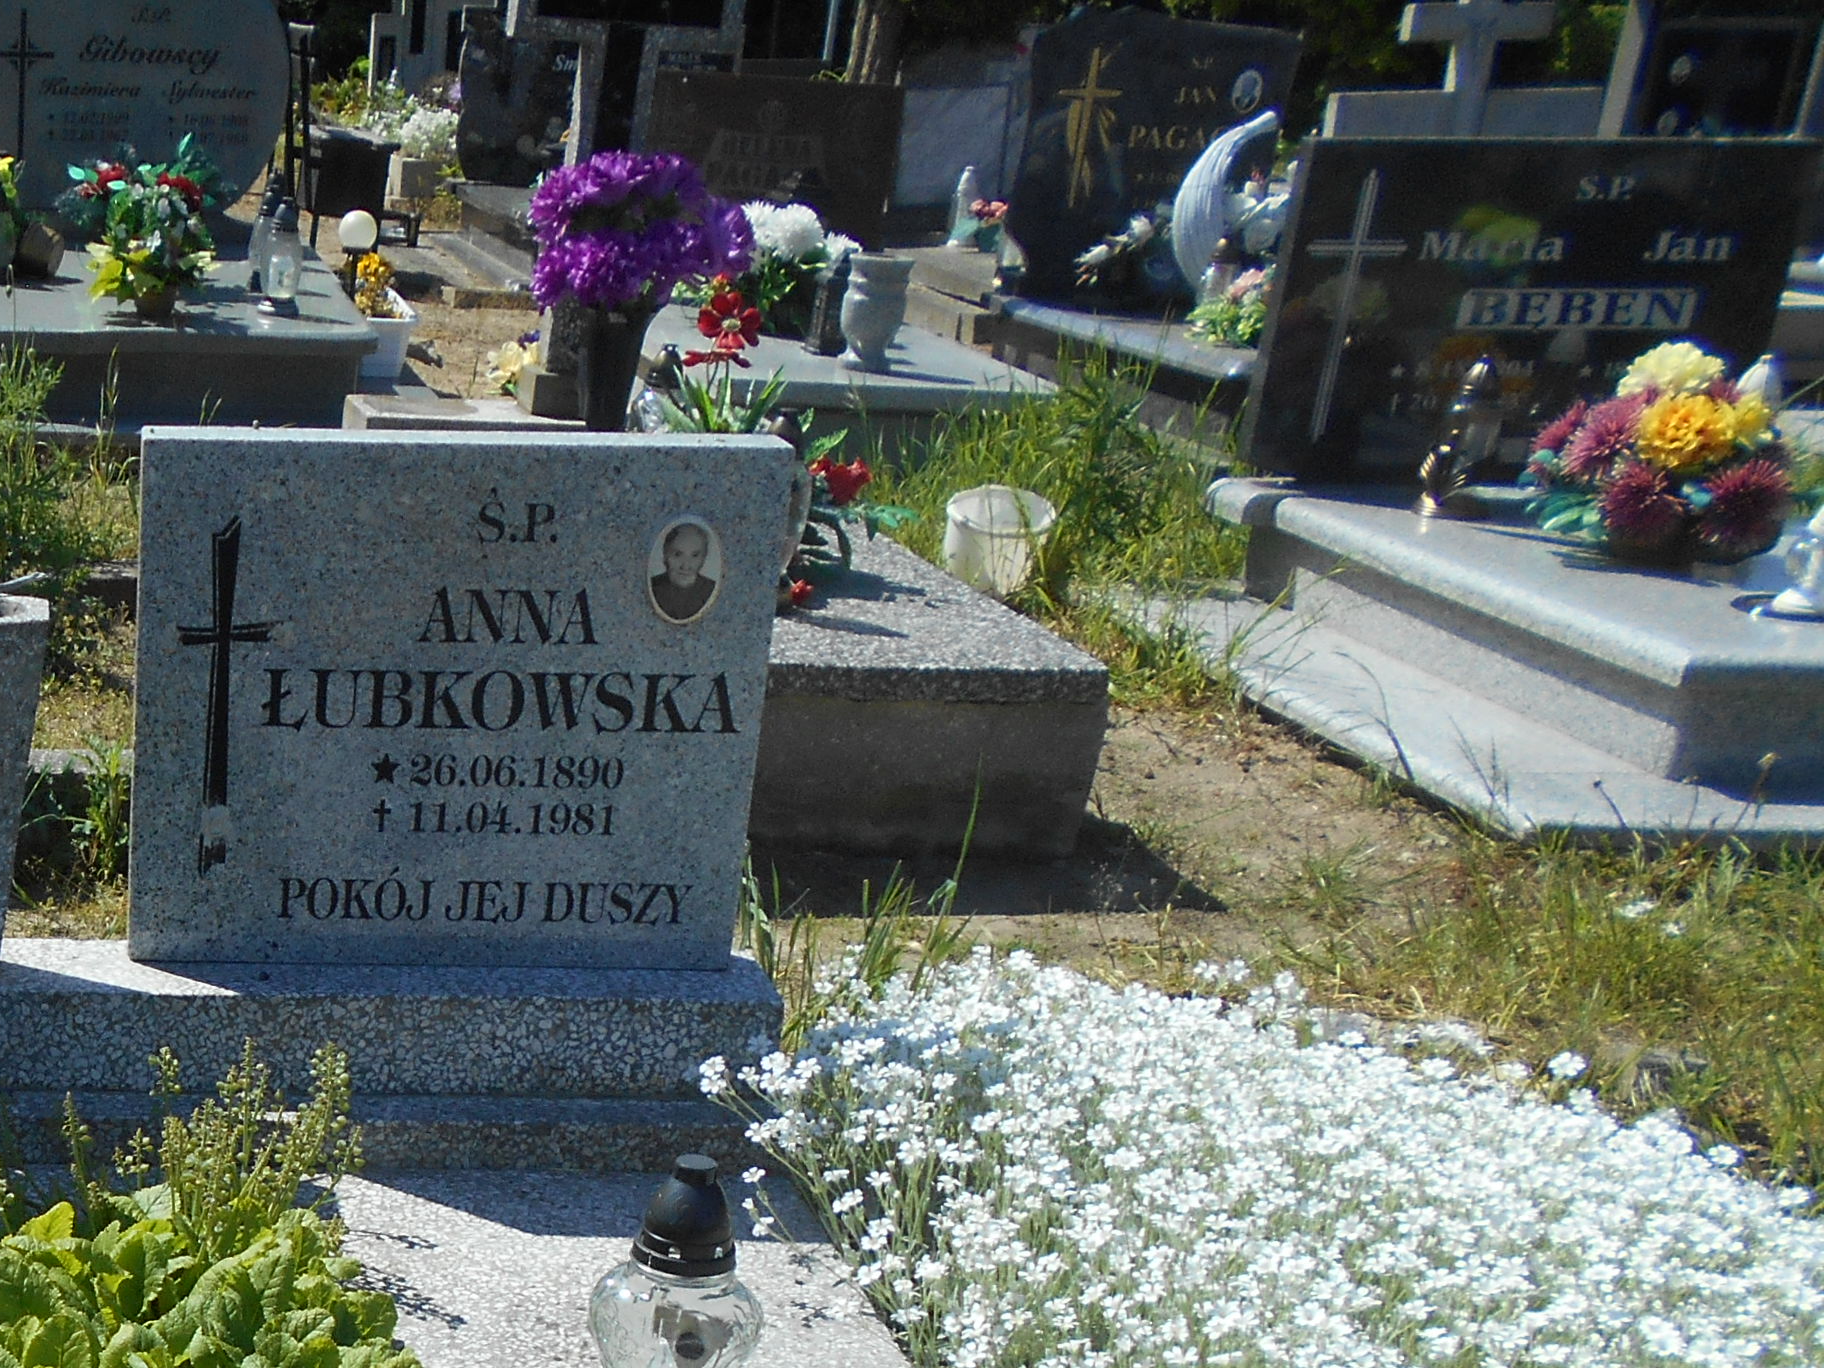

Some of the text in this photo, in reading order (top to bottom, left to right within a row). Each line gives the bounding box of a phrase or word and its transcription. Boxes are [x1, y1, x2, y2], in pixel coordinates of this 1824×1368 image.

[79, 32, 221, 75] Gibowscy
[39, 77, 142, 98] Kazimiera
[1173, 85, 1218, 105] JAN
[1128, 123, 1226, 150] PAGA
[1643, 229, 1733, 262] Jan
[478, 487, 559, 544] Ś.P.
[417, 586, 600, 646] ANNA
[261, 667, 742, 736] ŁUBKOWSKA
[408, 752, 626, 789] 26.06.1890
[409, 800, 616, 838] 11.04.1981
[276, 868, 694, 926] POKÓJ JEJ DUSZY
